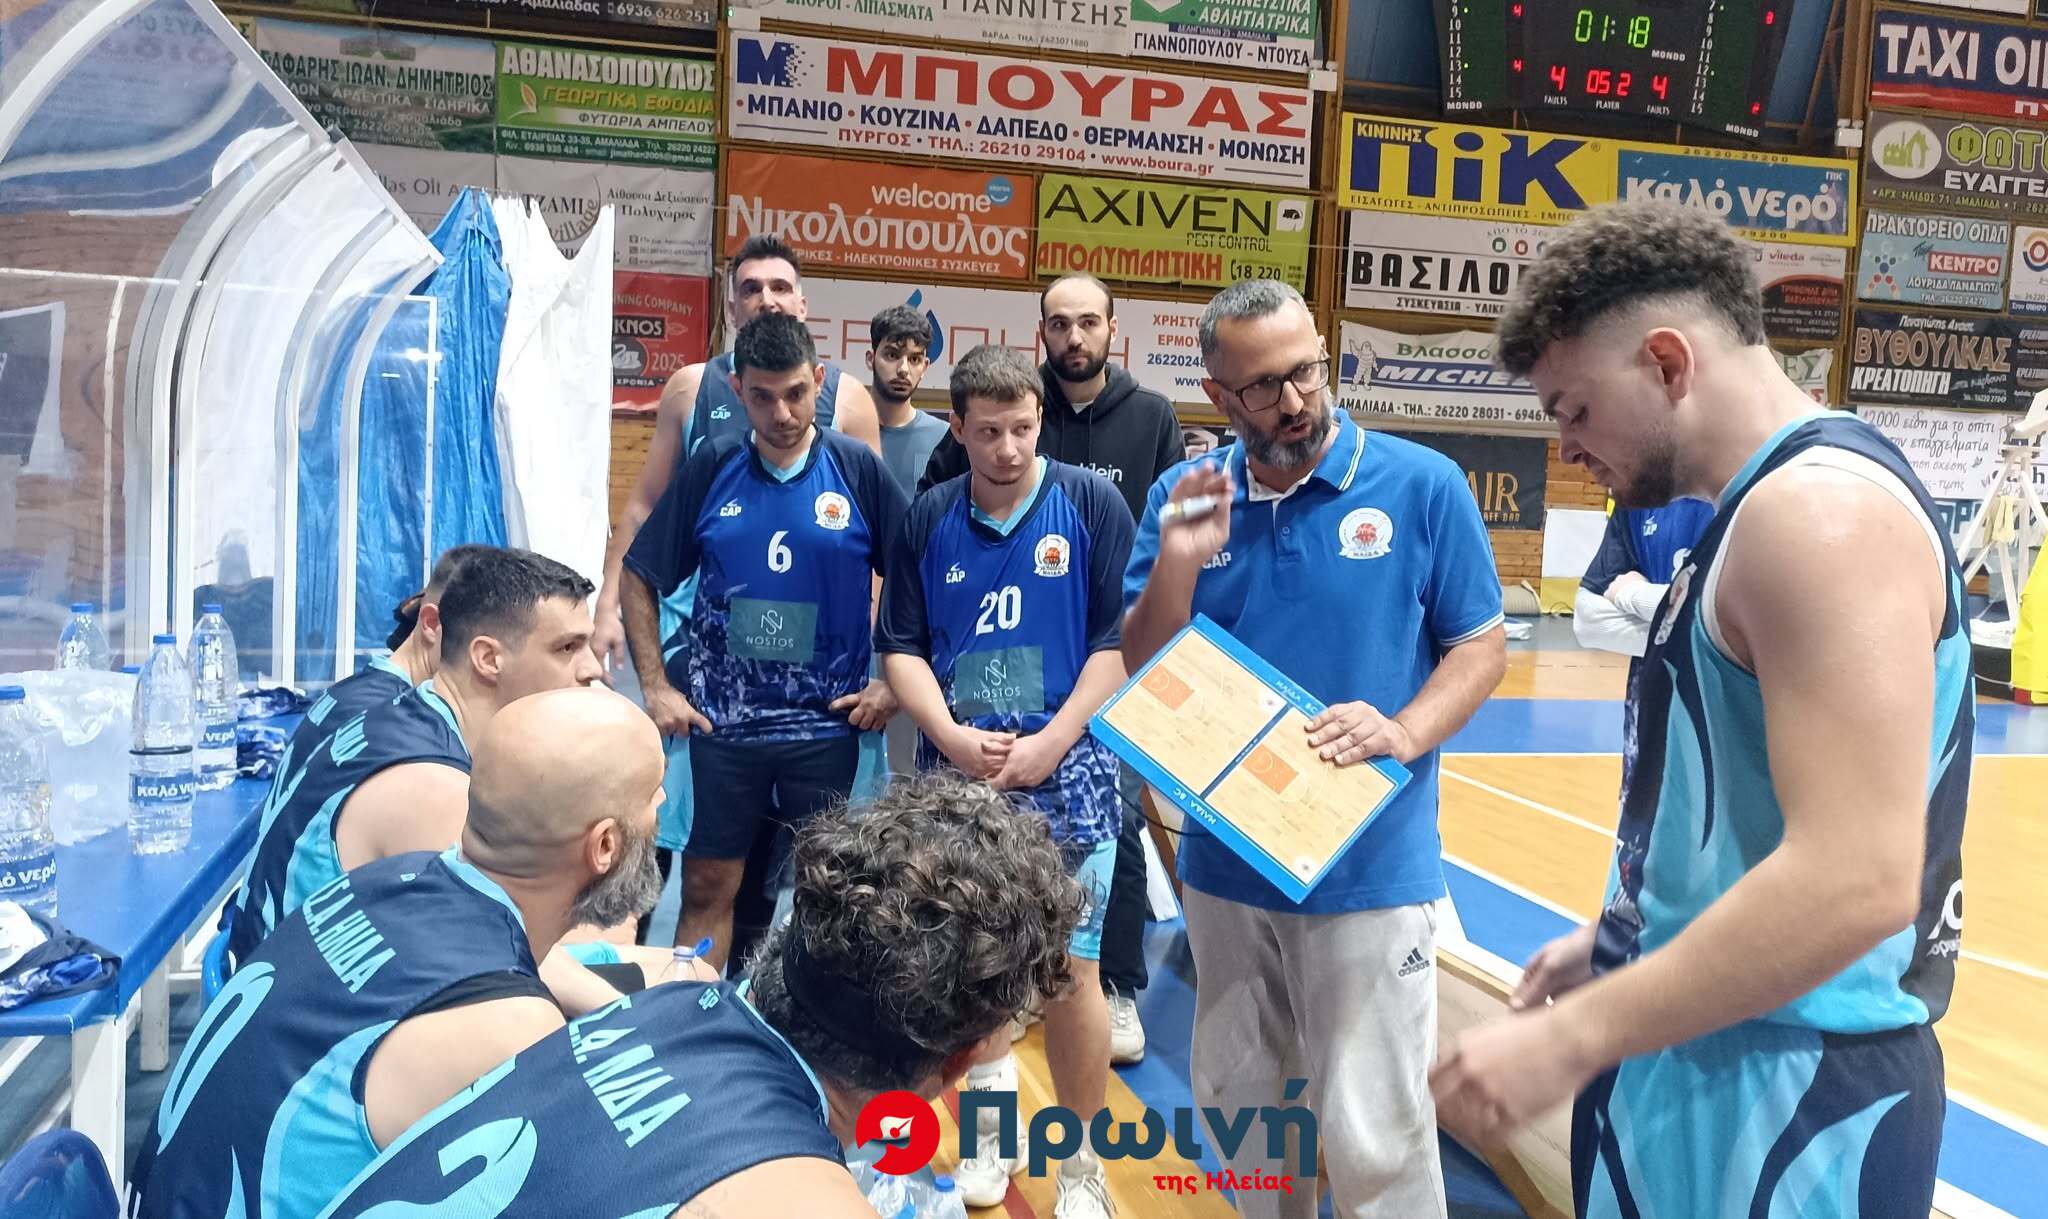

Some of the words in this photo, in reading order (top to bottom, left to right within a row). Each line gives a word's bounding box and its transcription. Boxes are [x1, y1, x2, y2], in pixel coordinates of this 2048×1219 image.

[617, 3, 652, 17] 6936
[655, 6, 682, 20] 626
[686, 9, 711, 23] 251
[853, 0, 934, 21] ΛΙΠΑΣΜΑΤΑ
[1199, 6, 1310, 34] ΑΘΛΗΤΙΑΤΡΙΚΑ
[1449, 19, 1462, 30] 10
[1449, 33, 1461, 44] 11
[1701, 38, 1713, 50] 10
[1134, 32, 1243, 60] ΓΙΑΝΝΟΠΟΥΛΟΥ
[1257, 45, 1310, 68] ΝΤΟΥΣΑ
[1449, 46, 1462, 58] 12
[1651, 50, 1685, 62] MONDO
[1699, 51, 1710, 63] 11
[502, 45, 716, 92] ΑΘΑΝΑΣΟΠΟΥΛΟΣ
[1449, 60, 1462, 72] 13
[1696, 64, 1709, 76] 12
[395, 66, 494, 98] ΔΗΜΗΤΡΙΟΣ
[1449, 74, 1462, 86] 14
[543, 87, 637, 109] ΓΕΩΡΓΙΚΑ
[644, 94, 715, 114] ΕΦΟΔΙΑ
[826, 46, 1308, 139] ΜΠΟΥΡΑΣ
[1449, 87, 1462, 98] 15
[1447, 101, 1483, 110] MONDO
[1544, 95, 1568, 105] FAULTS
[1595, 100, 1620, 111] PLAYER
[1646, 104, 1671, 116] FAULTS
[1690, 102, 1703, 115] 15
[578, 113, 643, 129] ΦΥΤΩΡΙΑ
[648, 119, 716, 133] ΑΜΠΕΛΟΥ
[747, 94, 843, 122] ΜΠΑΝΙΟ
[860, 104, 961, 133] ΚΟΥΖΙΝΑ
[976, 115, 1068, 143] ΔΑΠΕΔΟ
[1084, 126, 1203, 156] ΘΕΡΜΑΝΣΗ
[1218, 138, 1305, 165] ΜΟΝΩΣΗ
[1357, 122, 1422, 143] ΚΙΝΙΝΗΣ
[1725, 124, 1759, 138] MONDO
[838, 128, 912, 147] ΠΥΡΓΟΣ
[979, 141, 1031, 158] 26210
[1036, 145, 1086, 163] 29104
[1101, 155, 1214, 177] www.boura.gr
[1946, 123, 2048, 173] ΦΩΤ
[1944, 170, 2048, 198] ΕΥΑΓΓΕ
[871, 182, 993, 214] welcome
[1350, 194, 1415, 210] ΕΙΣΑΓΩΓΕΣ
[1424, 202, 1530, 219] ΑΝΤΙΠΡΟΣΩΠΕΙΕΣ
[1044, 183, 1271, 236] AXIVEN
[727, 194, 1028, 269] Νικολόπουλος
[1866, 213, 1965, 240] ΠΡΑΚΤΟΡΕΙΟ
[1968, 223, 2009, 244] ΟΠΑΠ
[1186, 232, 1215, 249] PEST
[1218, 234, 1273, 253] CONTROL
[844, 253, 939, 270] ΗΛΕΚΤΡΟΝΙΚΕΣ
[942, 259, 1001, 274] ΣΥΣΚΕΥΕΣ
[1257, 266, 1281, 280] 220
[1929, 254, 2000, 275] ΚΕΝΤΡΟ
[644, 294, 694, 317] COMPANY
[1854, 327, 2012, 373] ΒΥΘΟΥΛΚΑΣ
[1850, 366, 1952, 395] ΚΡΕΑΤΟΠΗΓΗ
[710, 409, 731, 420] CAP
[1338, 397, 1394, 414] ΑΜΑΛΙΑΔΑ
[1435, 405, 1469, 418] 26220
[1472, 406, 1505, 420] 28031
[720, 505, 742, 517] CAP
[767, 530, 792, 573] 6
[946, 570, 965, 583] CAP
[975, 585, 1022, 637] 20
[746, 636, 794, 649] NOSTOS
[973, 687, 1021, 699] NOSTOS
